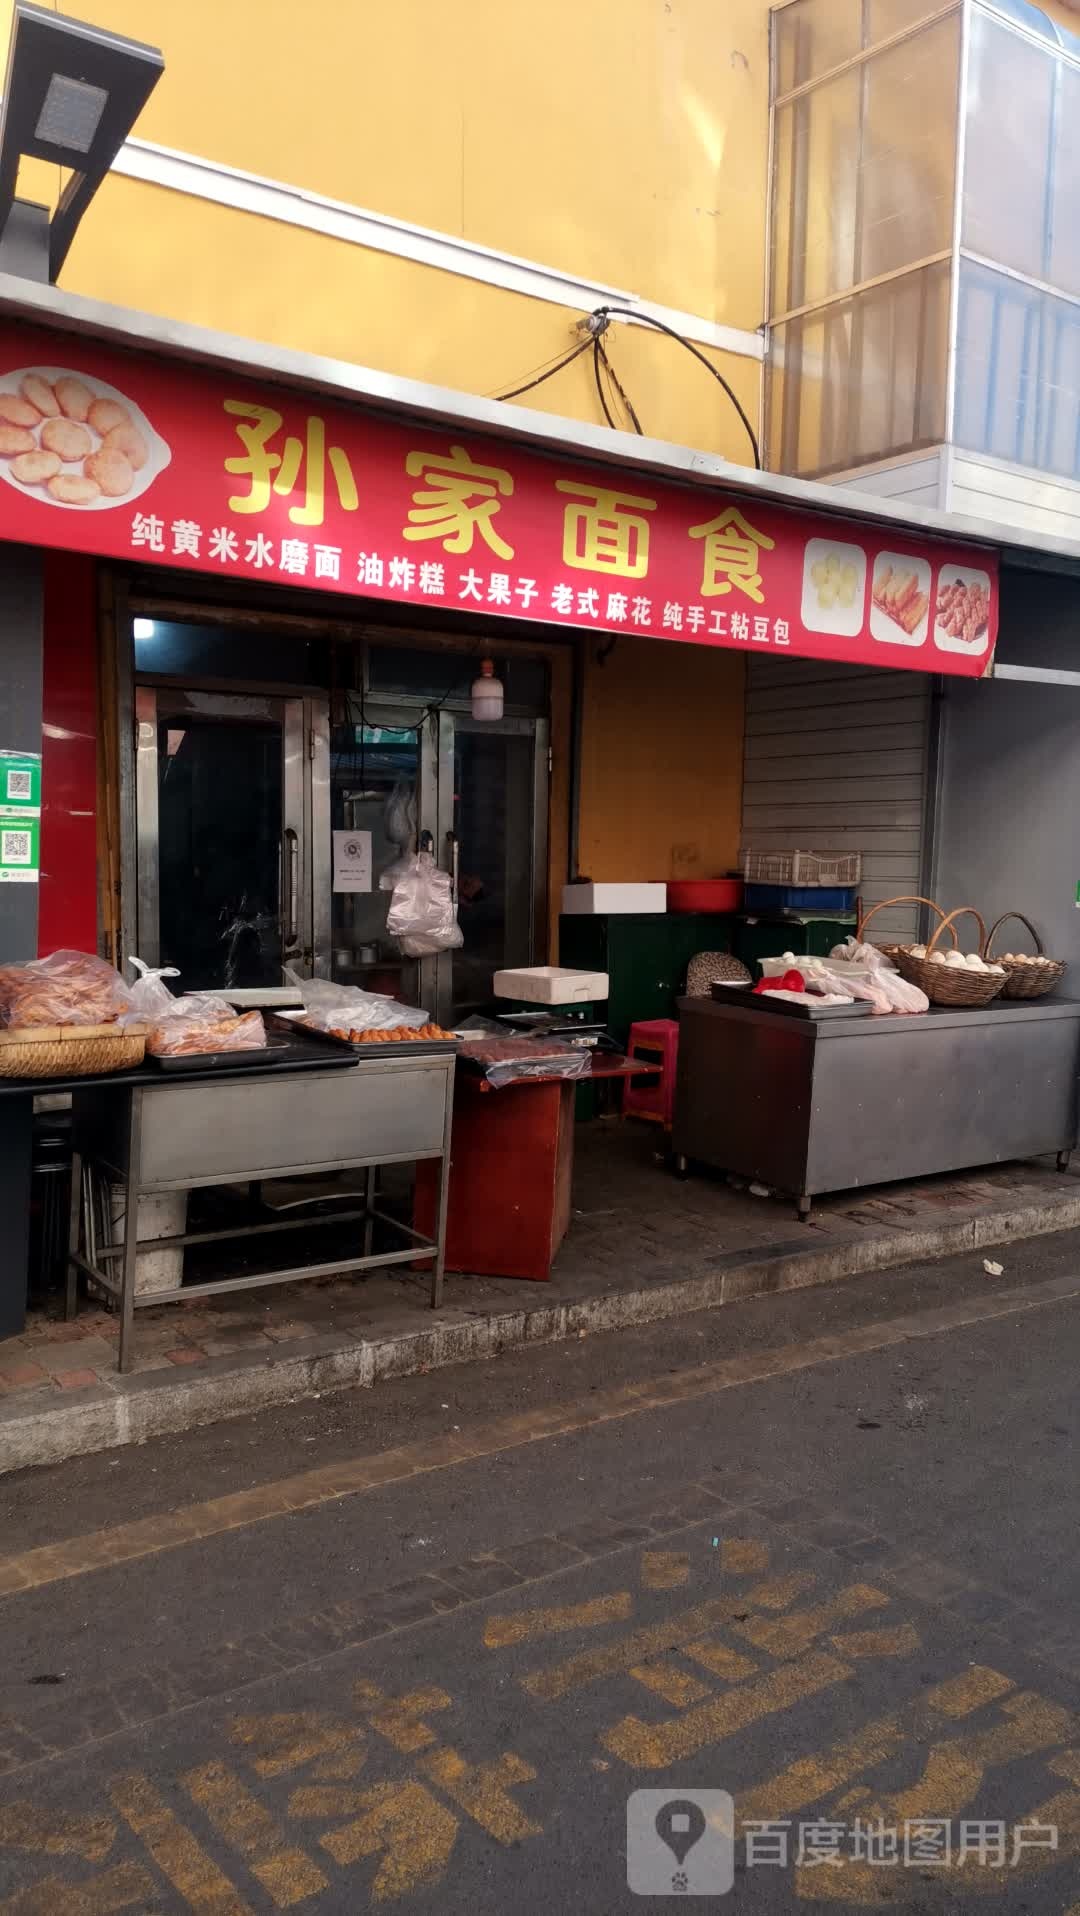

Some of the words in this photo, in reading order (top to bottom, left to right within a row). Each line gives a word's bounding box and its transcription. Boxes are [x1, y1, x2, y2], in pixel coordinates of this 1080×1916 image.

[131, 512, 342, 581] 纯黄米水磨面
[357, 552, 446, 596] 油炸糕
[458, 569, 539, 609] 大果子
[662, 600, 791, 646] 纯手工粘豆包
[223, 400, 775, 604] 孙家面食
